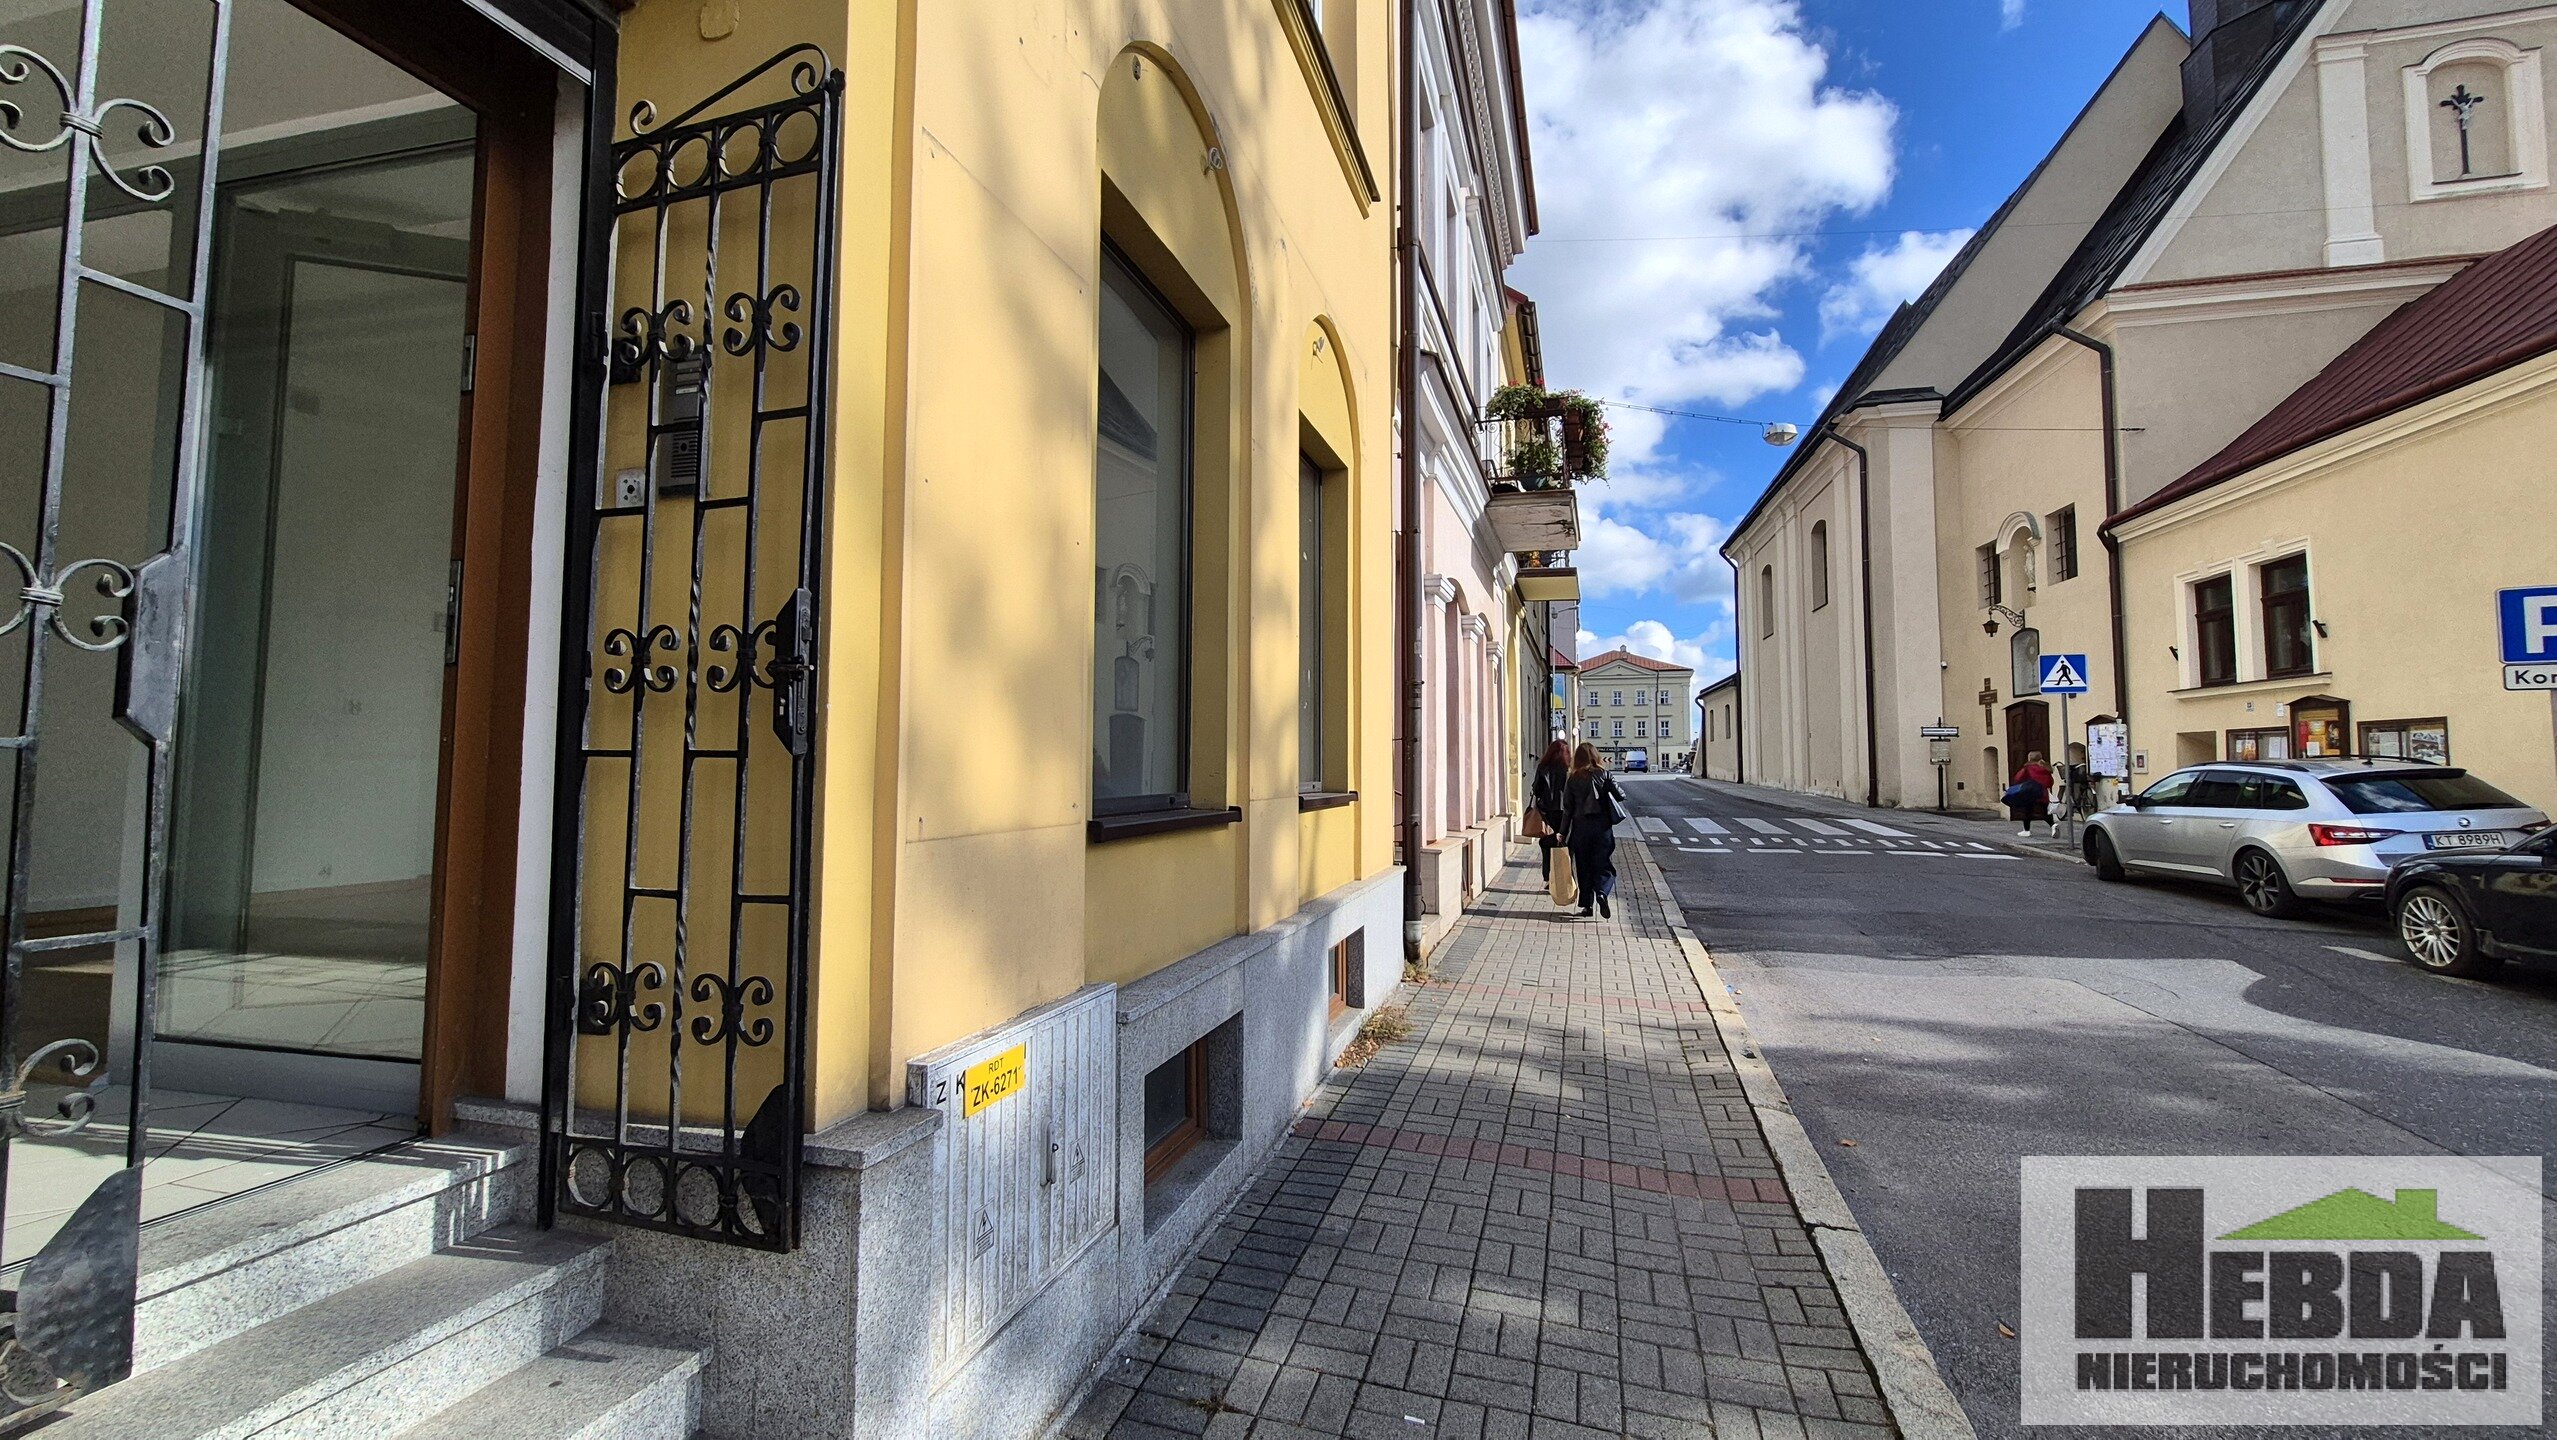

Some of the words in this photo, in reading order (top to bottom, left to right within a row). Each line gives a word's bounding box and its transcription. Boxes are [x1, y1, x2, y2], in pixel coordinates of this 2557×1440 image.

[2435, 836, 2452, 846] KT
[2458, 834, 2500, 846] 8989H
[988, 1057, 1004, 1074] RDT
[936, 1080, 947, 1105] Z
[972, 1068, 1019, 1107] ZK-6271
